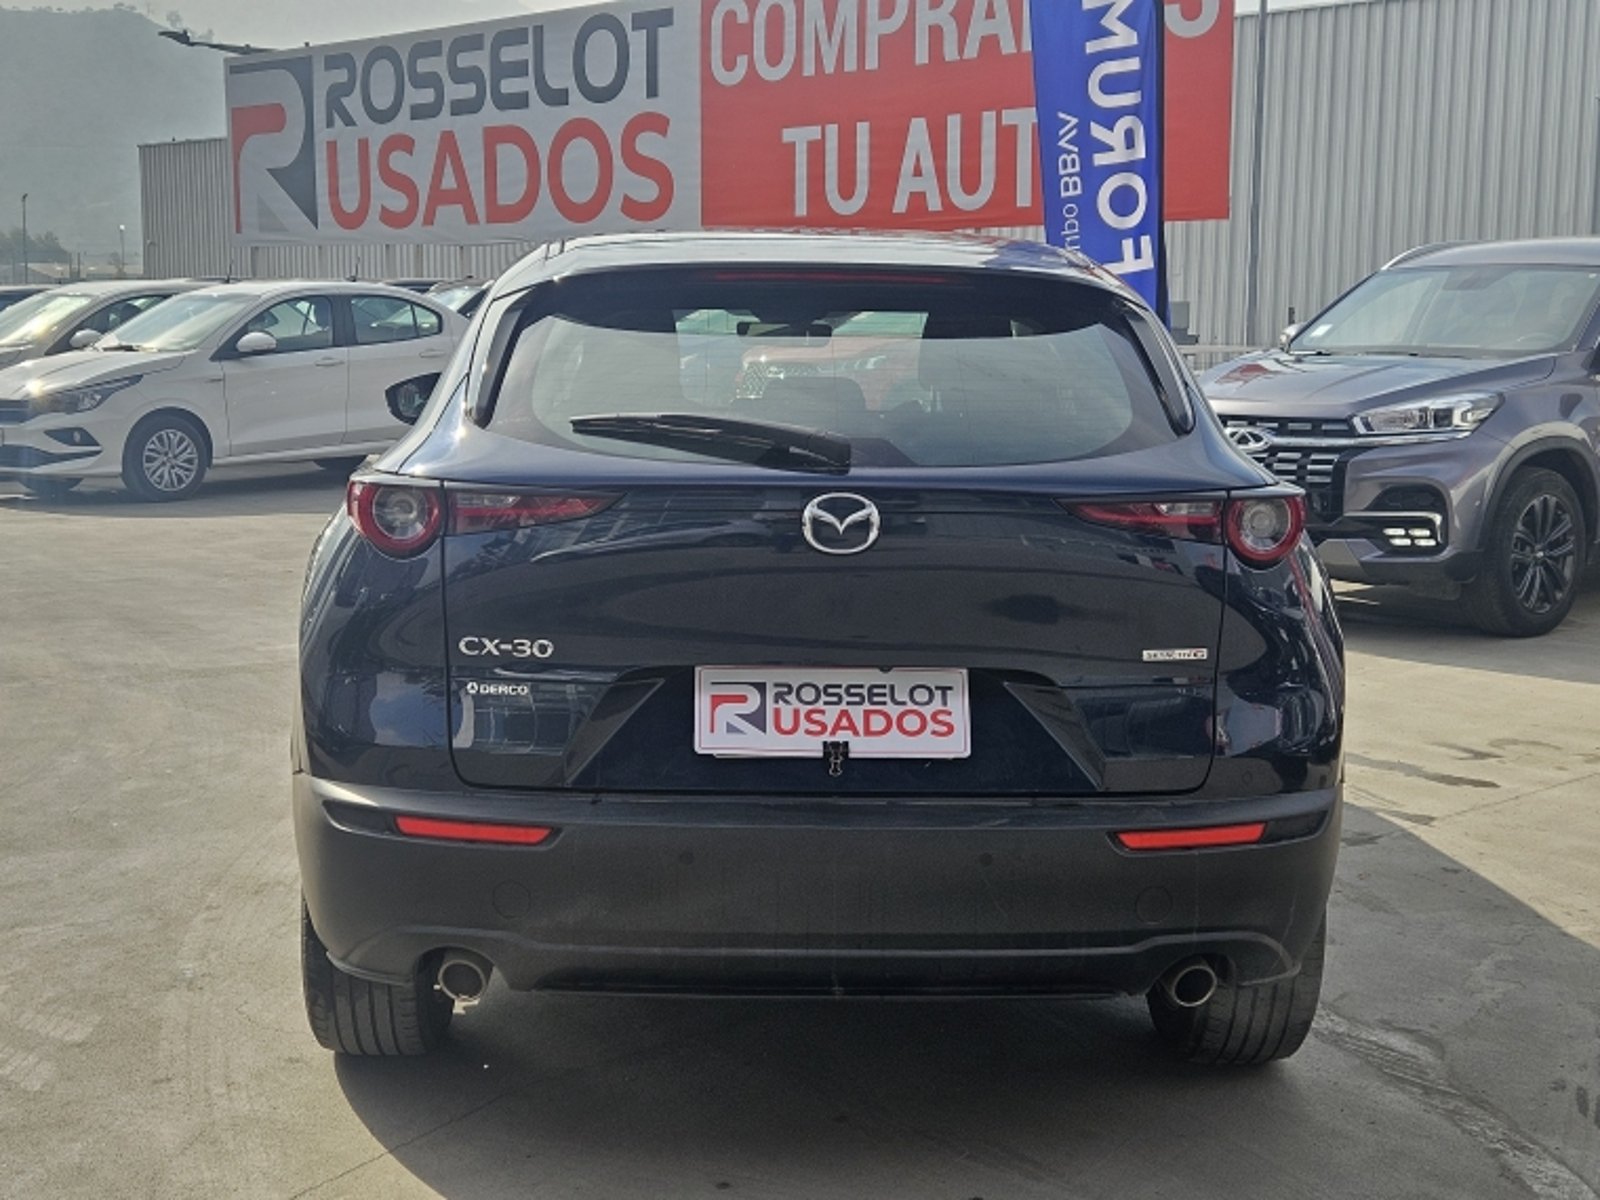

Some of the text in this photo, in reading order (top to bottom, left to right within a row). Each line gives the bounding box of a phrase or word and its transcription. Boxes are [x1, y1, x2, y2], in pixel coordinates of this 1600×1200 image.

[323, 7, 674, 129] ROSSELOT
[710, 0, 1219, 86] COMPRA
[325, 111, 675, 231] USADOS
[782, 107, 1037, 217] TU AUT
[458, 637, 554, 657] CX-30
[479, 683, 529, 695] DERCO
[773, 682, 954, 707] ROSSELOT
[773, 708, 955, 737] USADOS
